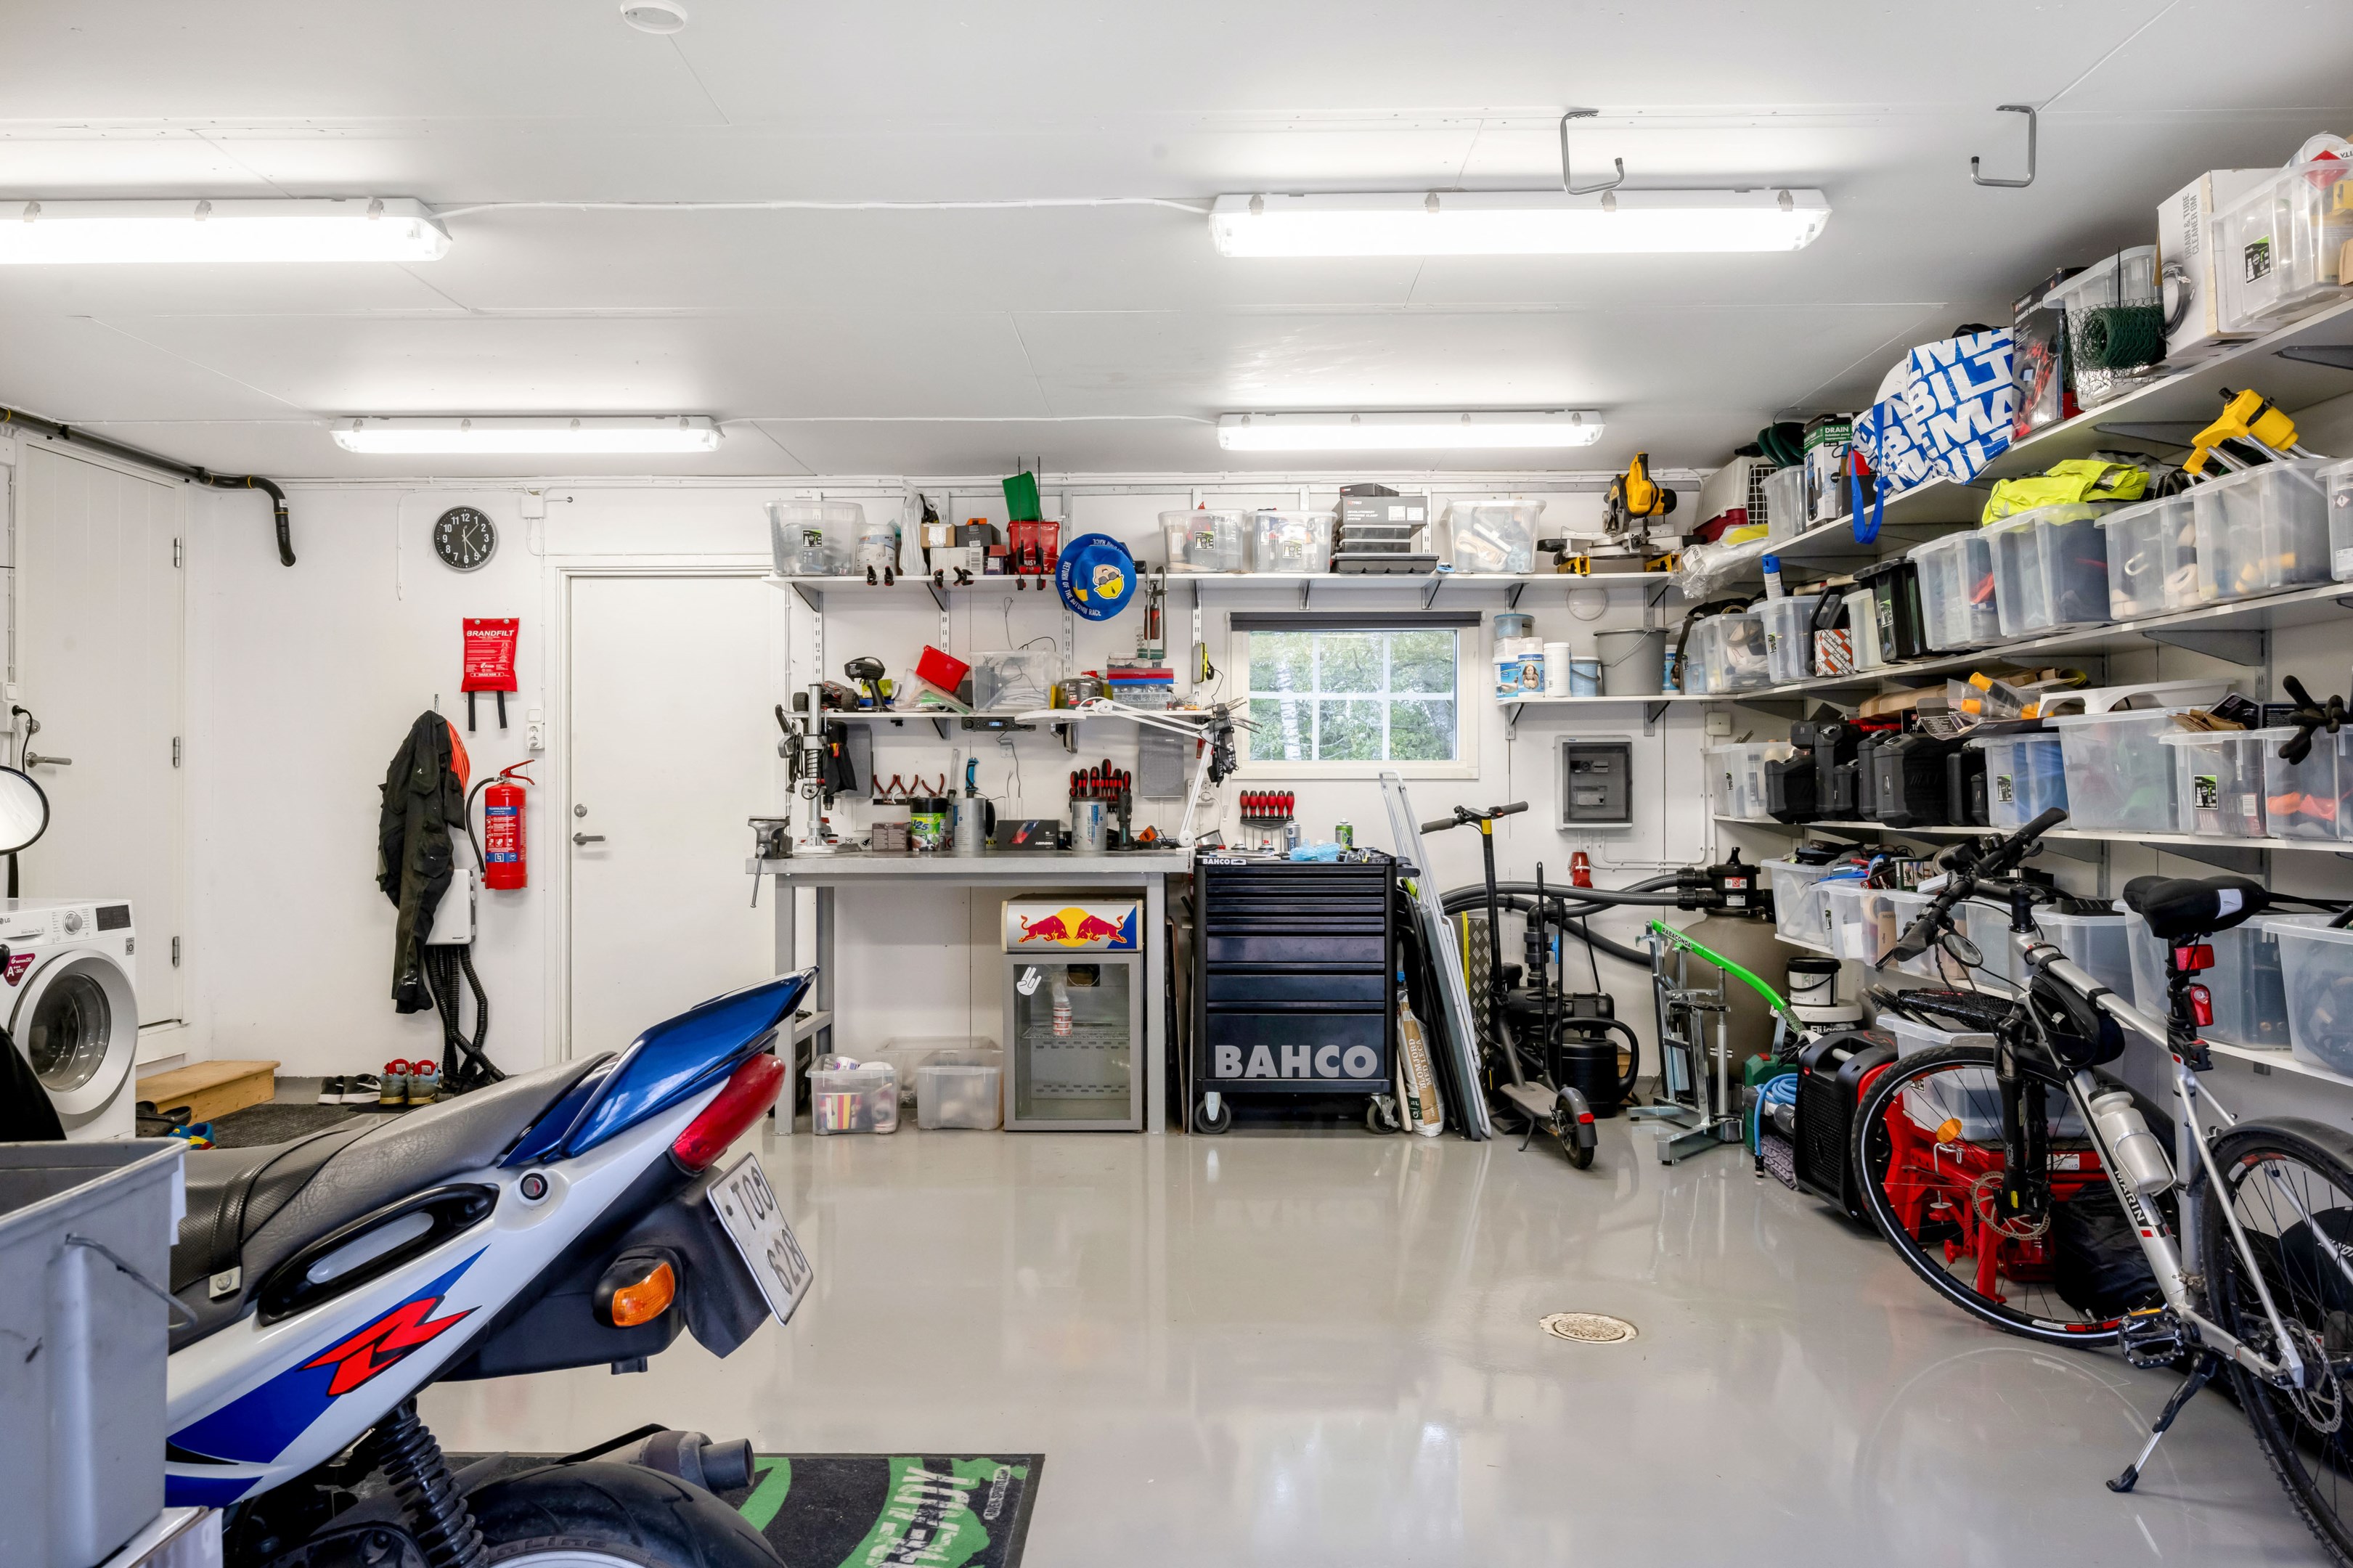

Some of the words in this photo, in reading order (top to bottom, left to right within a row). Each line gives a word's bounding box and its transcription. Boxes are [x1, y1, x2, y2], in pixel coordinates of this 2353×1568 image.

[2190, 213, 2199, 255] CLEANER
[451, 516, 460, 525] 11
[461, 513, 470, 522] 12
[481, 523, 486, 532] 2
[442, 534, 448, 543] 9
[484, 534, 489, 542] 3
[1061, 561, 1072, 581] RETURN
[1064, 589, 1073, 600] THE
[1069, 598, 1088, 615] AUTUMN
[1088, 608, 1101, 616] RACE
[1662, 927, 1692, 948] RABACONDA
[1215, 1045, 1378, 1078] BAHCO
[1416, 1039, 1428, 1065] LECA
[1408, 1038, 1427, 1089] BLOMJORD
[1422, 1065, 1432, 1085] MED
[2114, 1169, 2145, 1222] MARIN
[766, 1228, 805, 1296] 628
